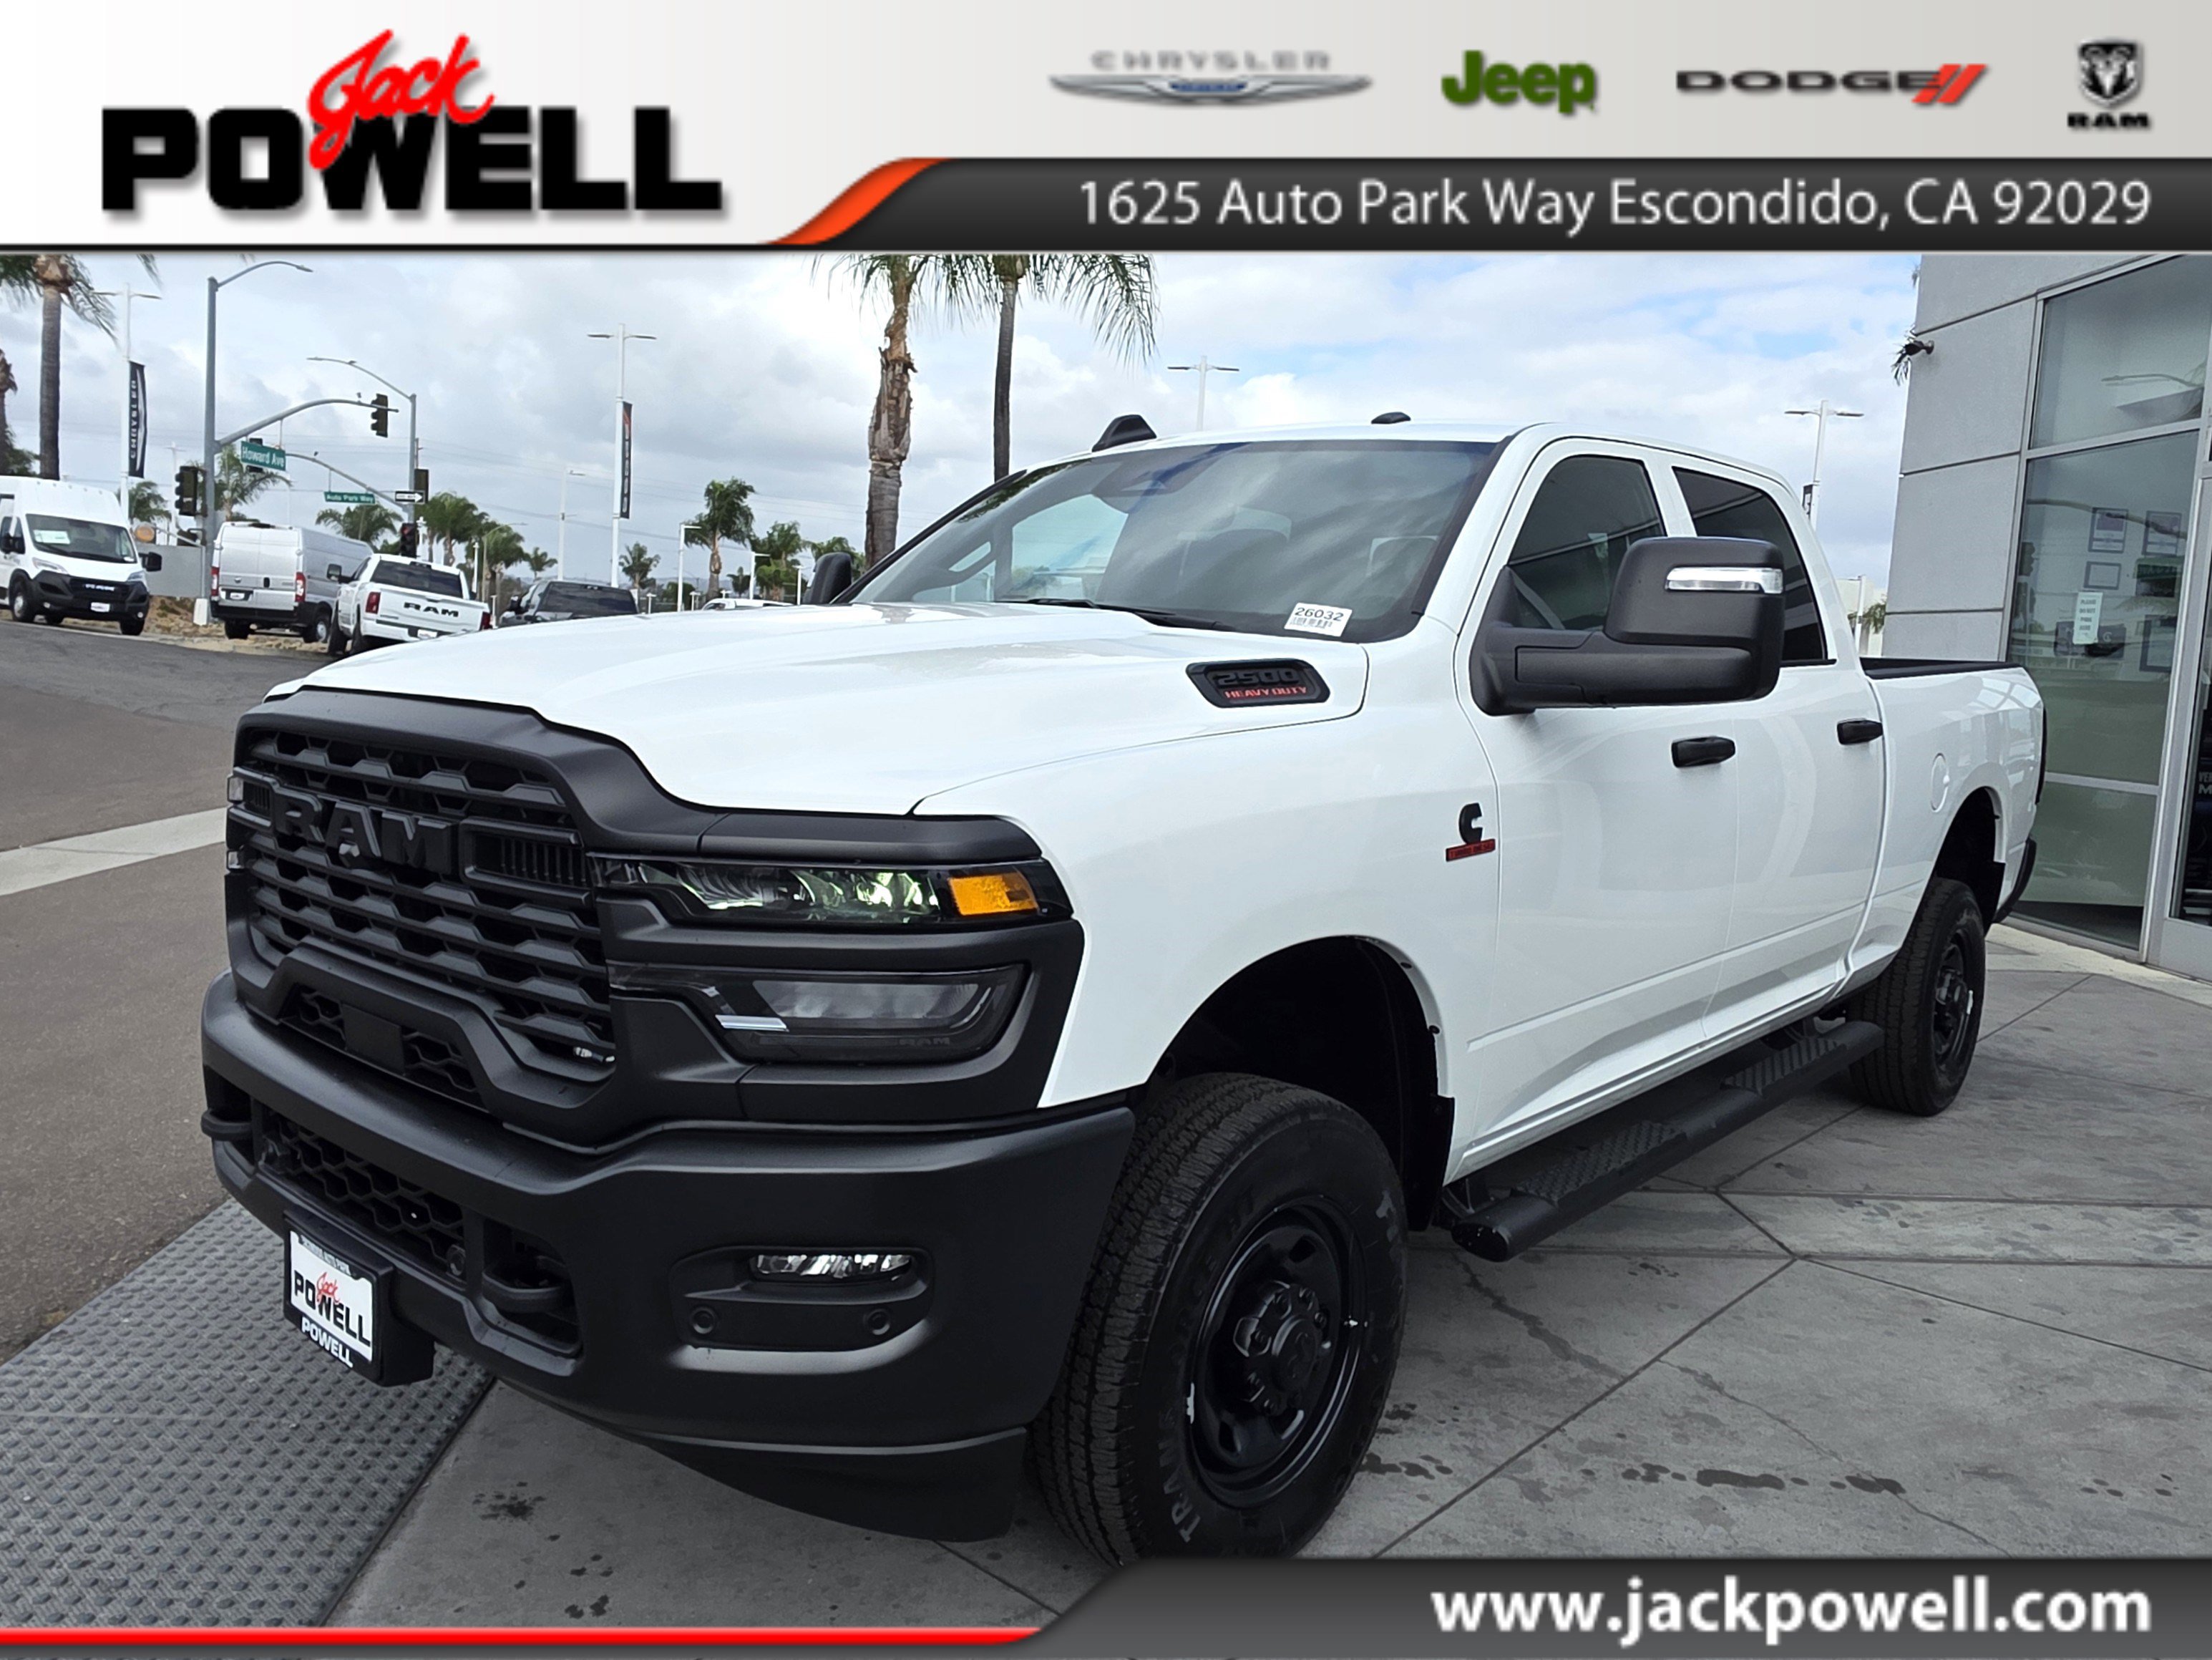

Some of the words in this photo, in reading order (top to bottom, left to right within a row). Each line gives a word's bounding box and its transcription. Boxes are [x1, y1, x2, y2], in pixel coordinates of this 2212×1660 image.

[243, 445, 271, 465] Howard
[271, 452, 284, 467] Ave
[404, 602, 459, 617] RAM
[1295, 607, 1345, 622] 26032
[1217, 669, 1302, 687] 2500
[1224, 688, 1270, 699] HEAVY
[1273, 686, 1307, 696] DUTY
[274, 785, 454, 875] RAM
[316, 1271, 341, 1304] Jack
[294, 1269, 371, 1347] POWELL
[301, 1316, 354, 1369] POWELL
